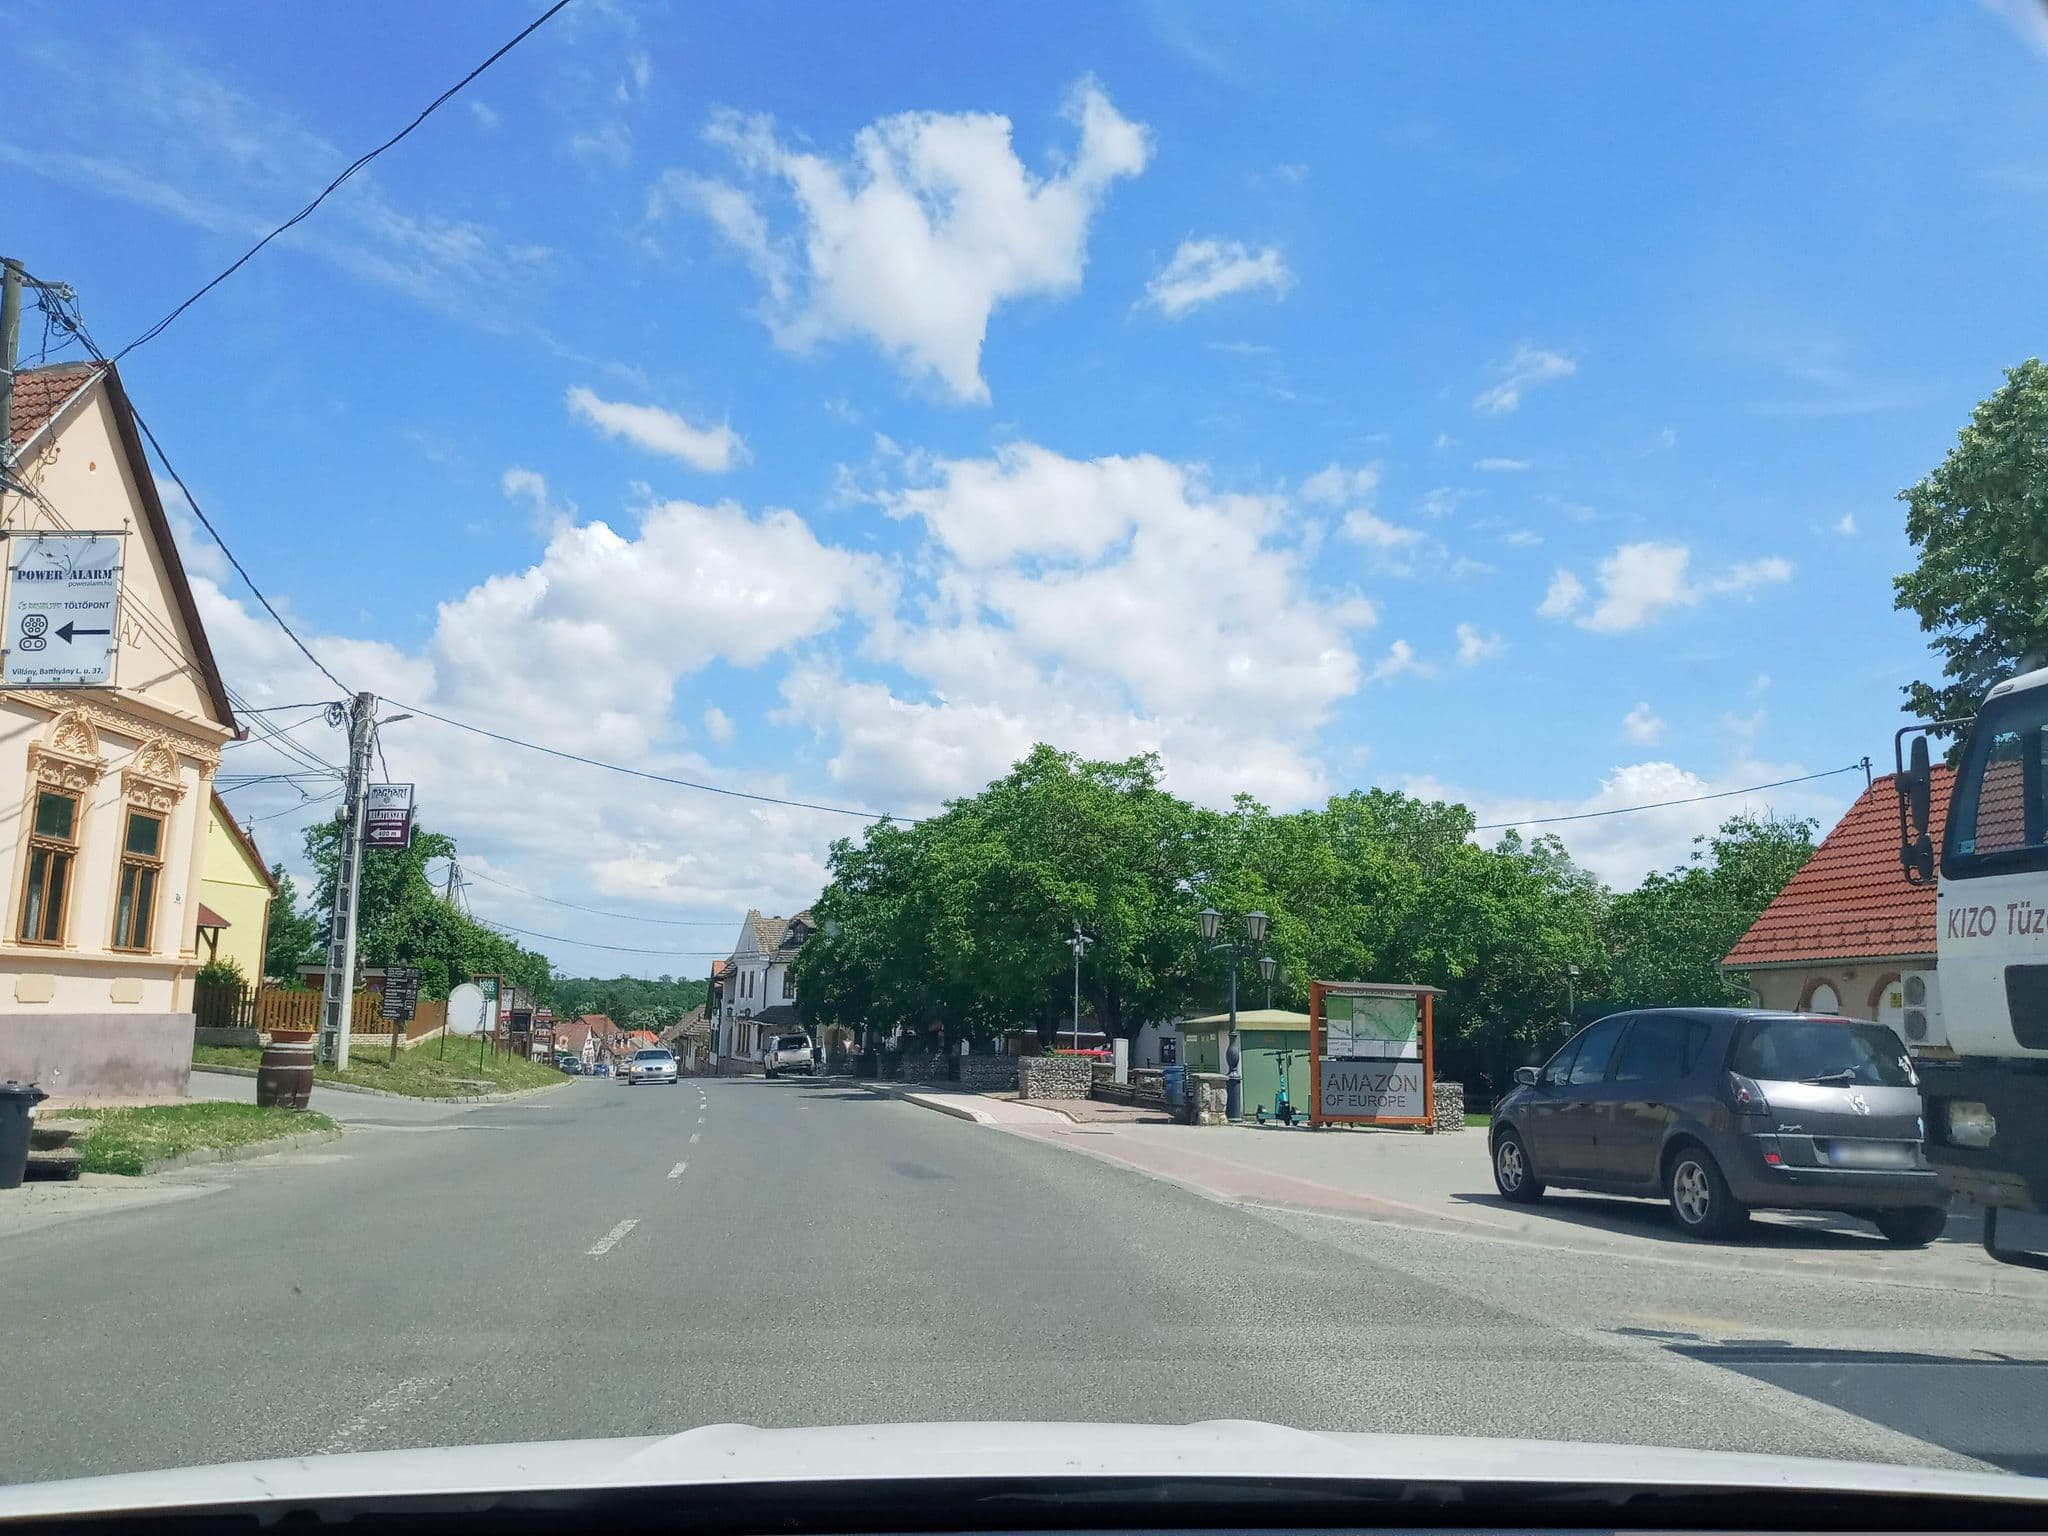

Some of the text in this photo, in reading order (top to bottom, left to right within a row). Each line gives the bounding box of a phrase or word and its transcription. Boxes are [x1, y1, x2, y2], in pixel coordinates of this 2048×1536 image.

[17, 569, 113, 580] POWER ALARM
[1947, 901, 2048, 938] KIZO Tüz
[1326, 1074, 1417, 1093] AMAZON
[1326, 1094, 1406, 1108] OF EUROPE
